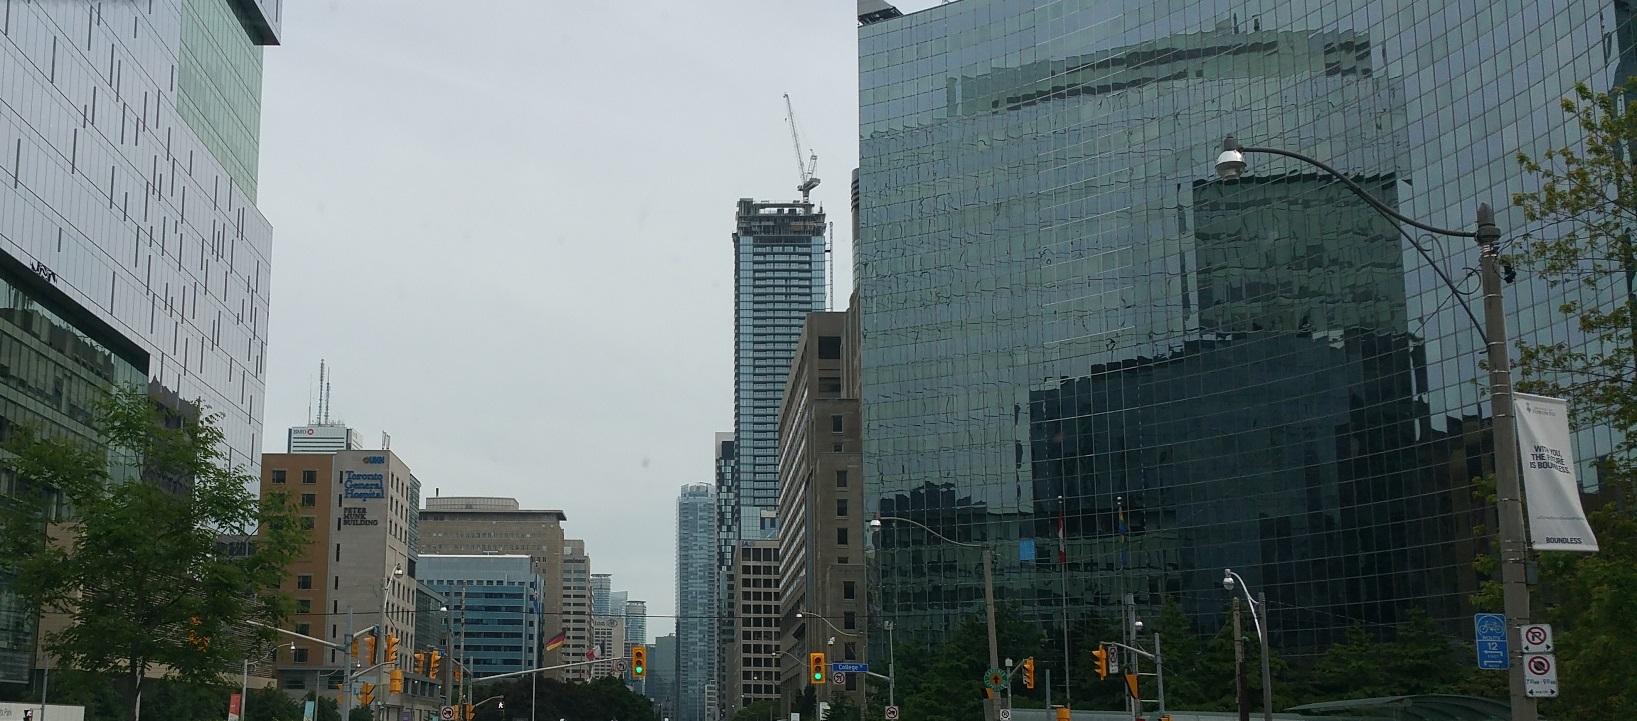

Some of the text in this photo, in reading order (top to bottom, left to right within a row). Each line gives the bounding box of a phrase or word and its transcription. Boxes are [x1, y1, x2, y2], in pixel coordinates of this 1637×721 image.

[1531, 453, 1546, 461] THE
[345, 471, 383, 480] Toronto
[344, 480, 383, 490] General
[344, 489, 385, 502] Hospital
[1488, 642, 1498, 650] 12
